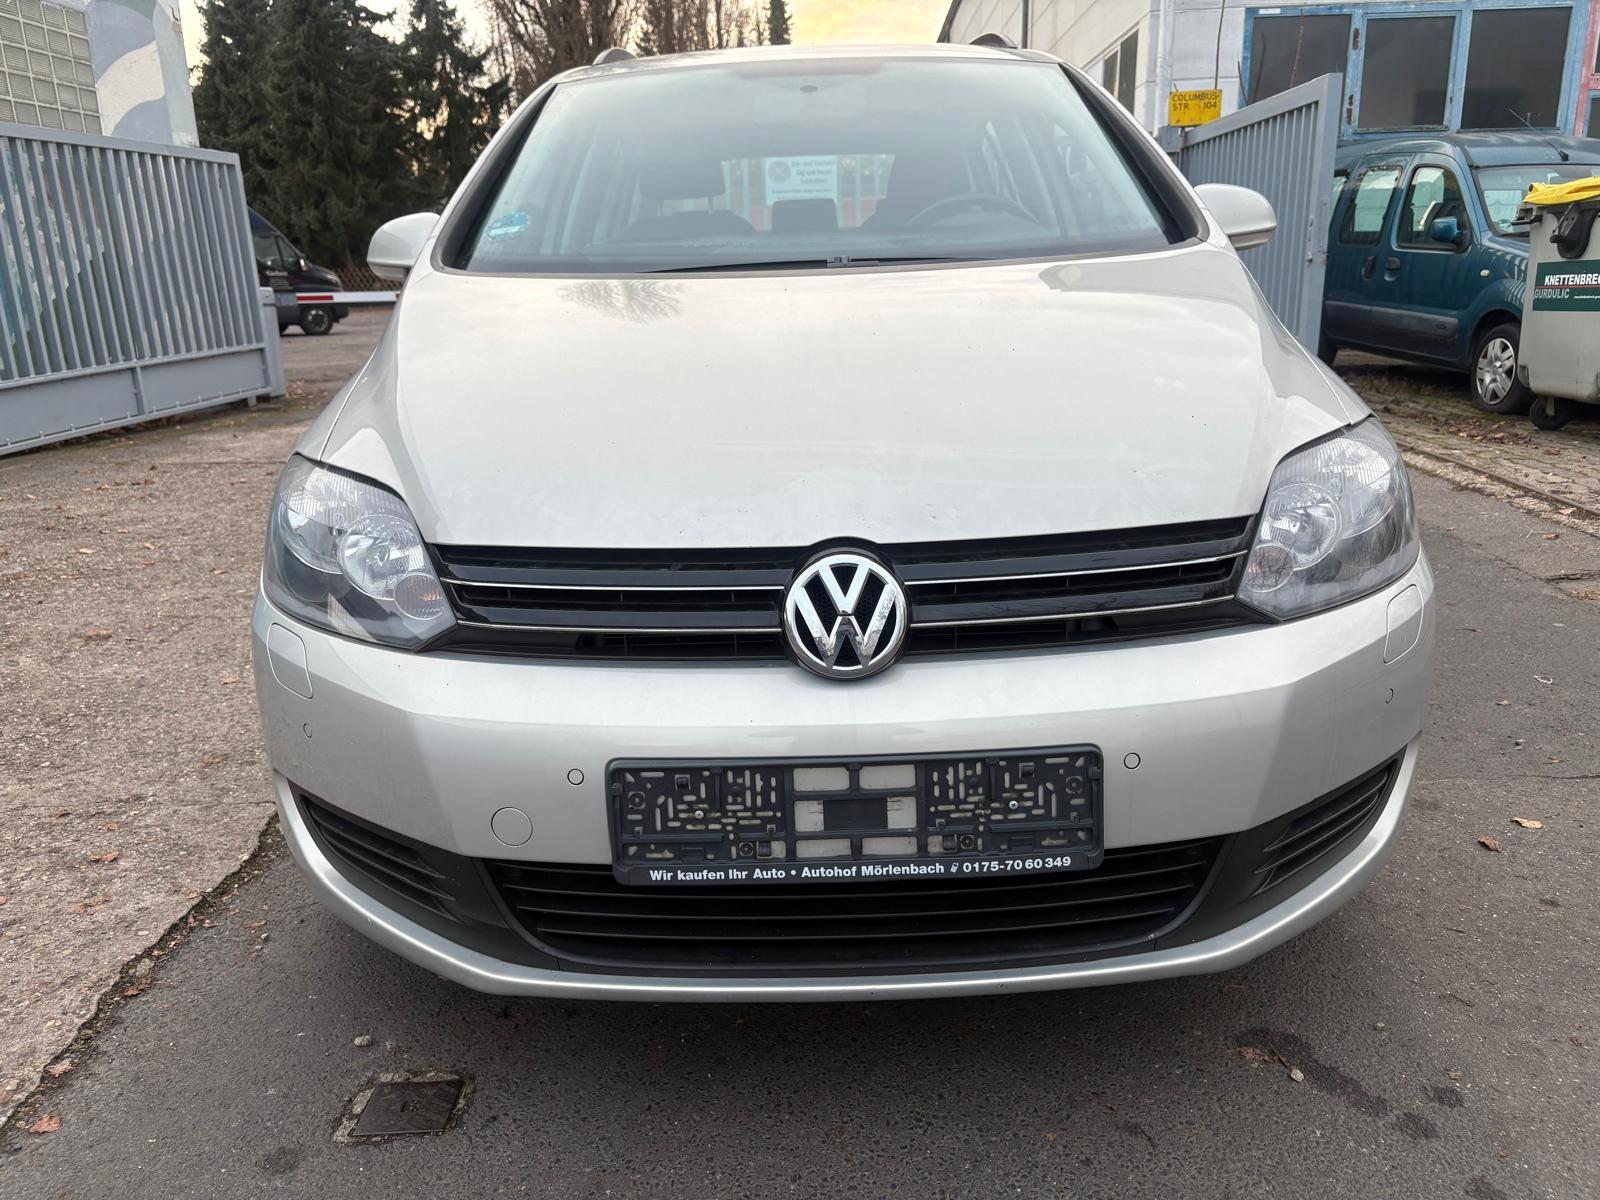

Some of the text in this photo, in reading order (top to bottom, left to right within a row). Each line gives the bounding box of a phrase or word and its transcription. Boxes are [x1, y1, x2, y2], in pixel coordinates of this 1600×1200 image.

[1203, 101, 1216, 109] 104
[1535, 288, 1570, 299] GURDULIC
[650, 869, 673, 881] Wir
[677, 868, 725, 881] kaufen
[728, 868, 748, 880] Ihr
[753, 867, 786, 879] Auto
[801, 865, 857, 878] Autohof
[861, 862, 945, 877] Mörlenbach
